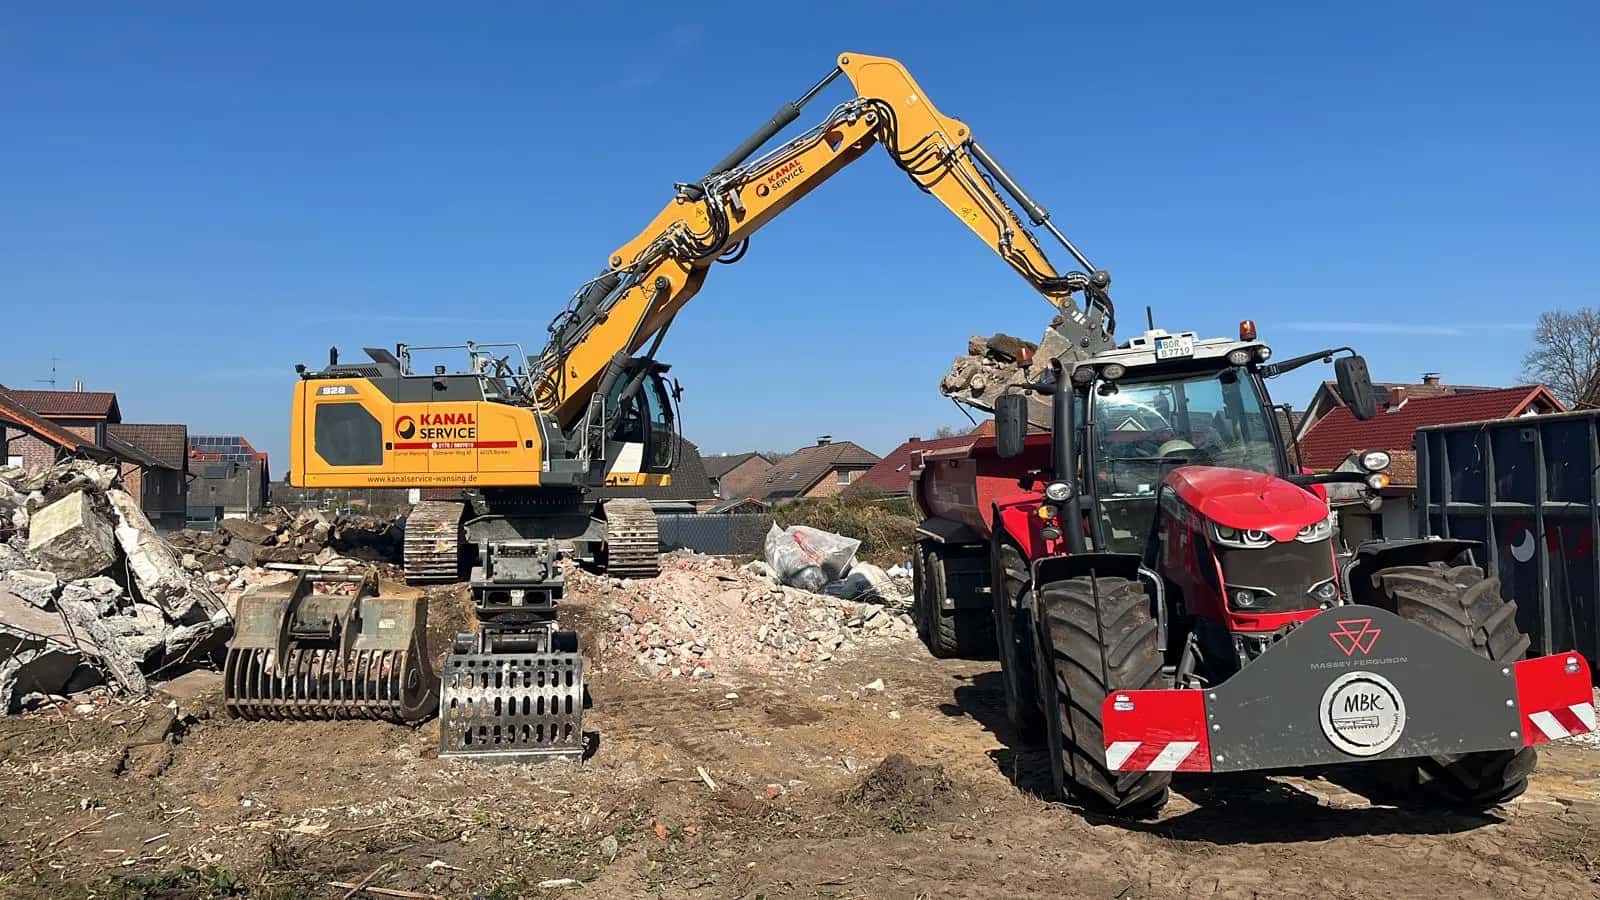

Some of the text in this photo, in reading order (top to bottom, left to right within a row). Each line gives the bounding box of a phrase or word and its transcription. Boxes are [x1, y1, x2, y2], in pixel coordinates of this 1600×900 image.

[768, 160, 801, 183] KANAL
[771, 166, 805, 190] SERVICE
[1163, 340, 1180, 349] BOR
[420, 412, 476, 425] KANAL
[420, 427, 476, 439] SERVICE
[367, 474, 478, 485] www.kanalservice-wansing.de
[1310, 657, 1408, 670] MASSEY FERGUSON
[1344, 693, 1384, 712] MBK
